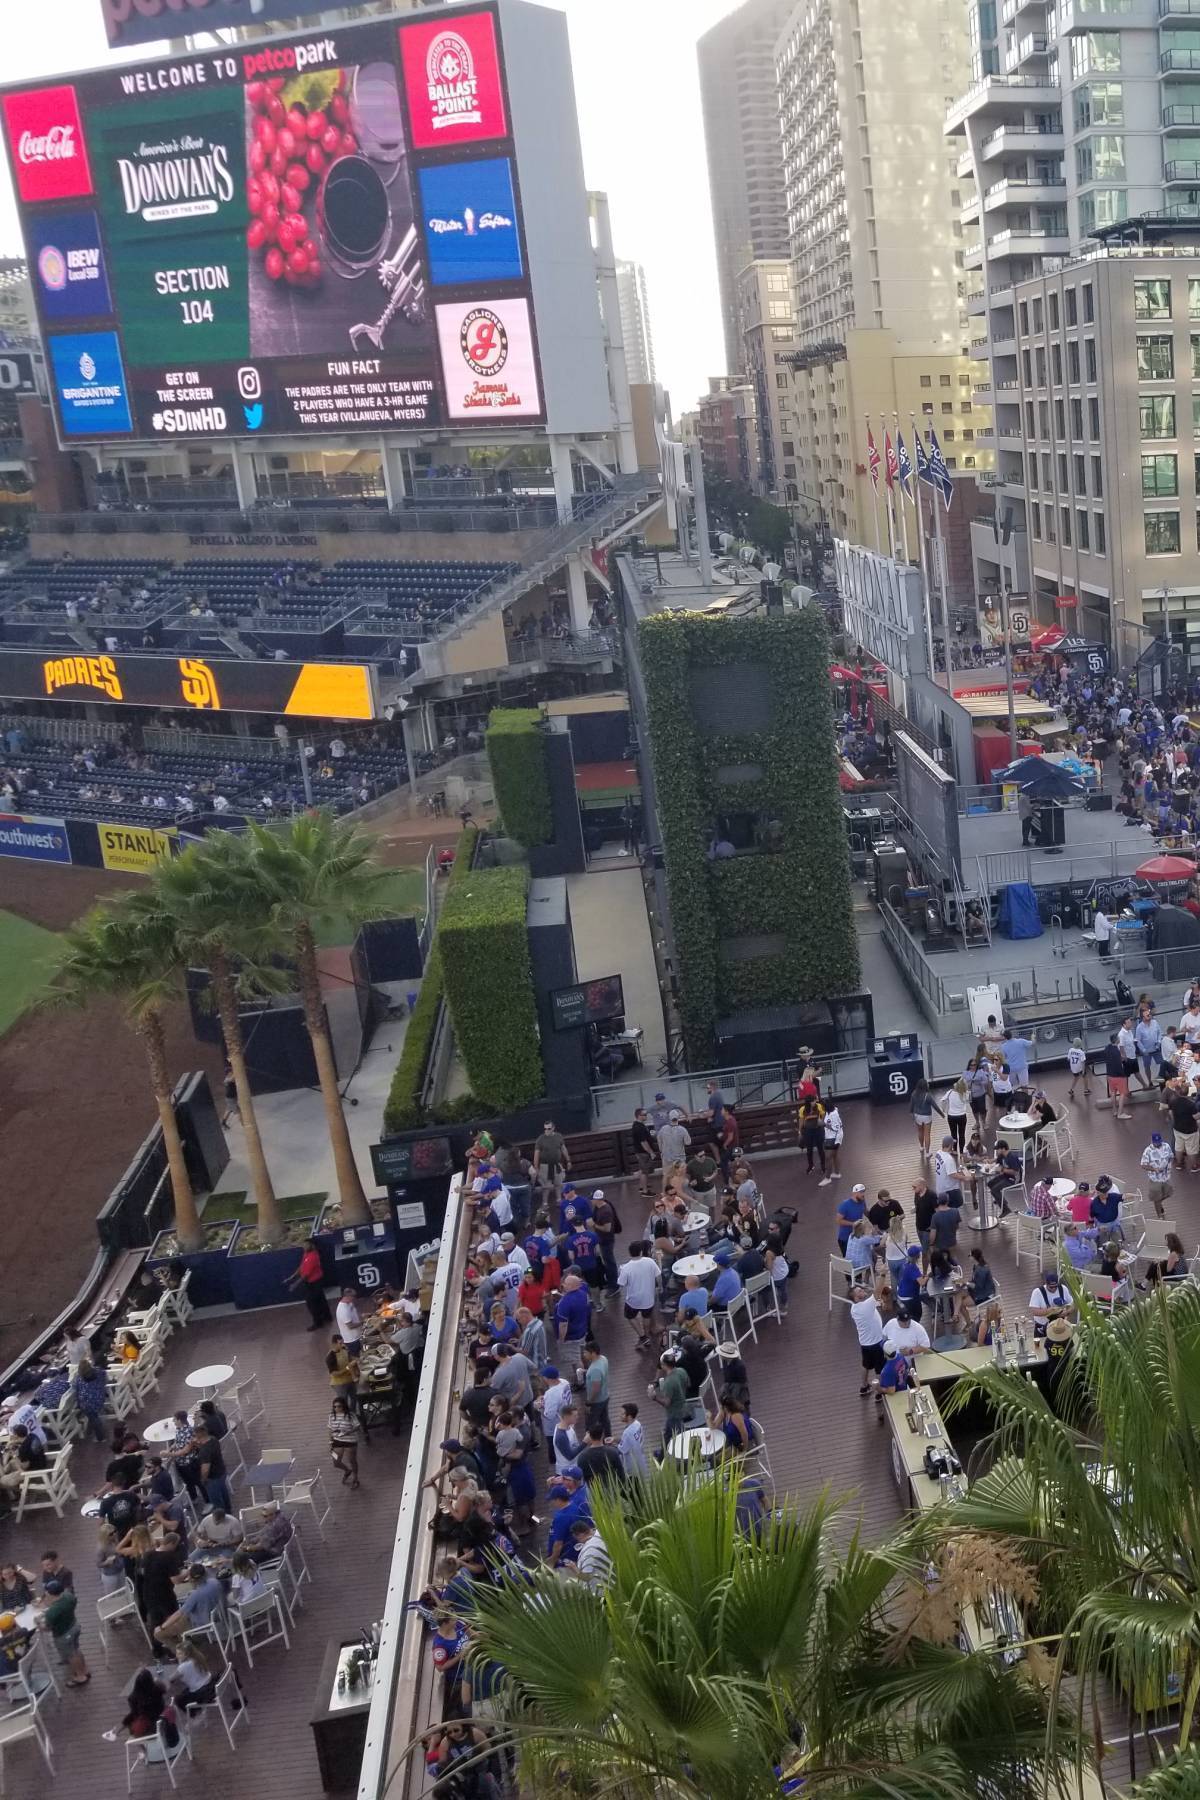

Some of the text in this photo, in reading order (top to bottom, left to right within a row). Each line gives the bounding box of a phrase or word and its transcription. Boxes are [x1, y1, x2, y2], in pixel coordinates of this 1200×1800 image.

[120, 60, 205, 95] WELCOME
[213, 58, 237, 80] TO
[428, 80, 477, 100] BALLAST
[438, 96, 473, 114] POINT
[117, 143, 234, 213] DONOVAN'S
[67, 249, 100, 268] IBEW
[155, 265, 229, 294] SECTION
[180, 300, 214, 324] 104
[461, 310, 504, 334] GAGLIONE
[328, 360, 380, 376] FUN FACT
[464, 348, 507, 376] BROTHERS
[166, 372, 199, 386] GET ON
[285, 380, 432, 398] THE PADRES ARE THE ONLY TEAM WITH
[62, 386, 122, 400] BRIGANTINE
[156, 388, 213, 402] THE SCREEN
[294, 402, 299, 410] 2
[300, 400, 334, 410] PLAYERS
[335, 398, 353, 408] WHO
[355, 398, 375, 408] HAVE
[376, 397, 382, 406] A
[405, 395, 428, 405] GAME
[300, 414, 318, 424] THIS
[318, 412, 339, 422] YEAR
[394, 408, 426, 420] MYERS)
[44, 655, 124, 700] PADRES
[889, 1072, 909, 1095] SD
[357, 1263, 380, 1288] SD
